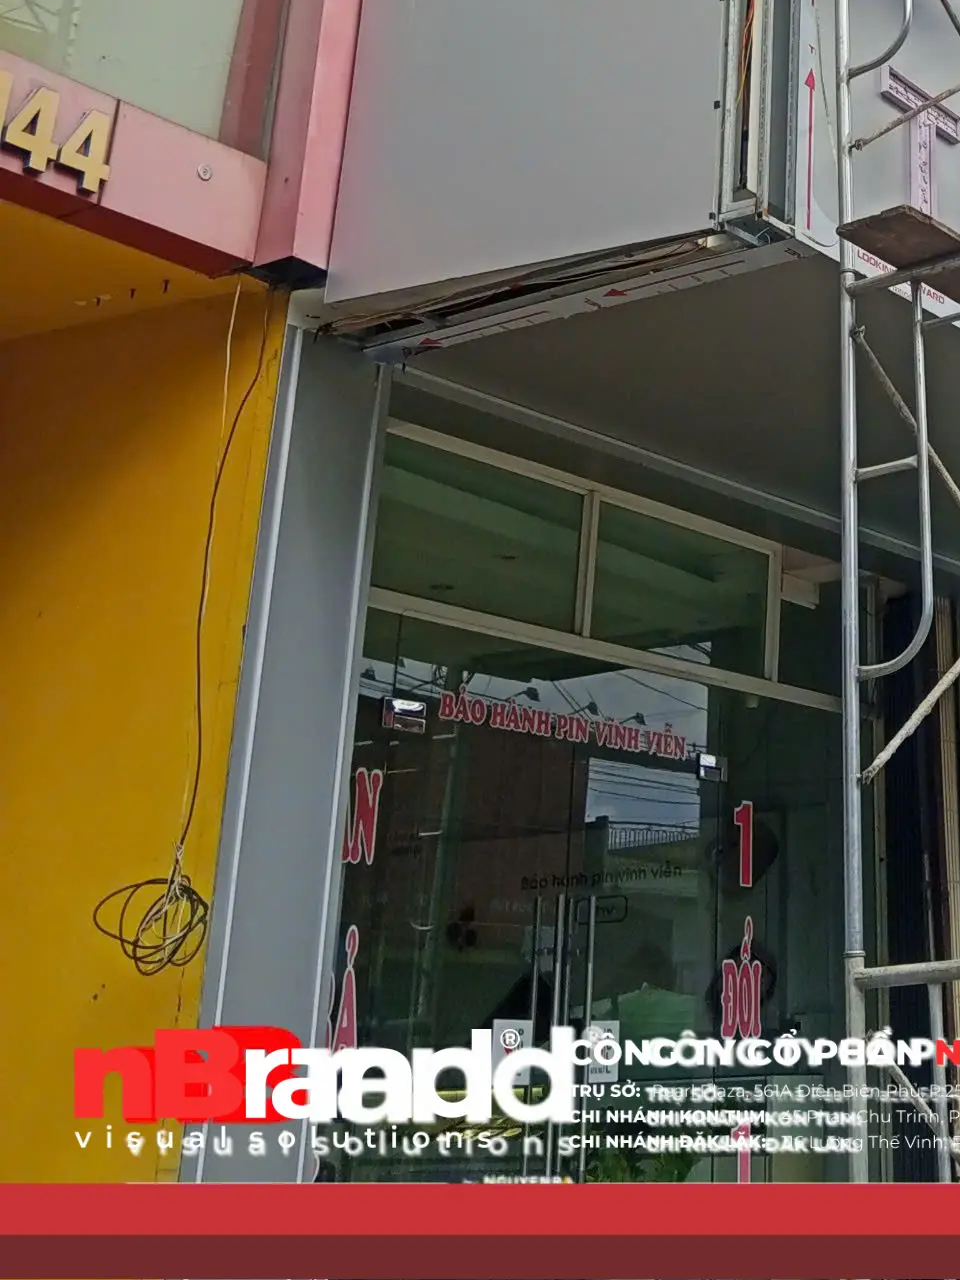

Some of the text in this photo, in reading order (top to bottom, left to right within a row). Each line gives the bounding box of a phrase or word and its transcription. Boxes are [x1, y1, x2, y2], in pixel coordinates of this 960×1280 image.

[439, 684, 688, 760] BẢO HÀNH PIN VĨNH VIỄN
[734, 800, 754, 888] 1
